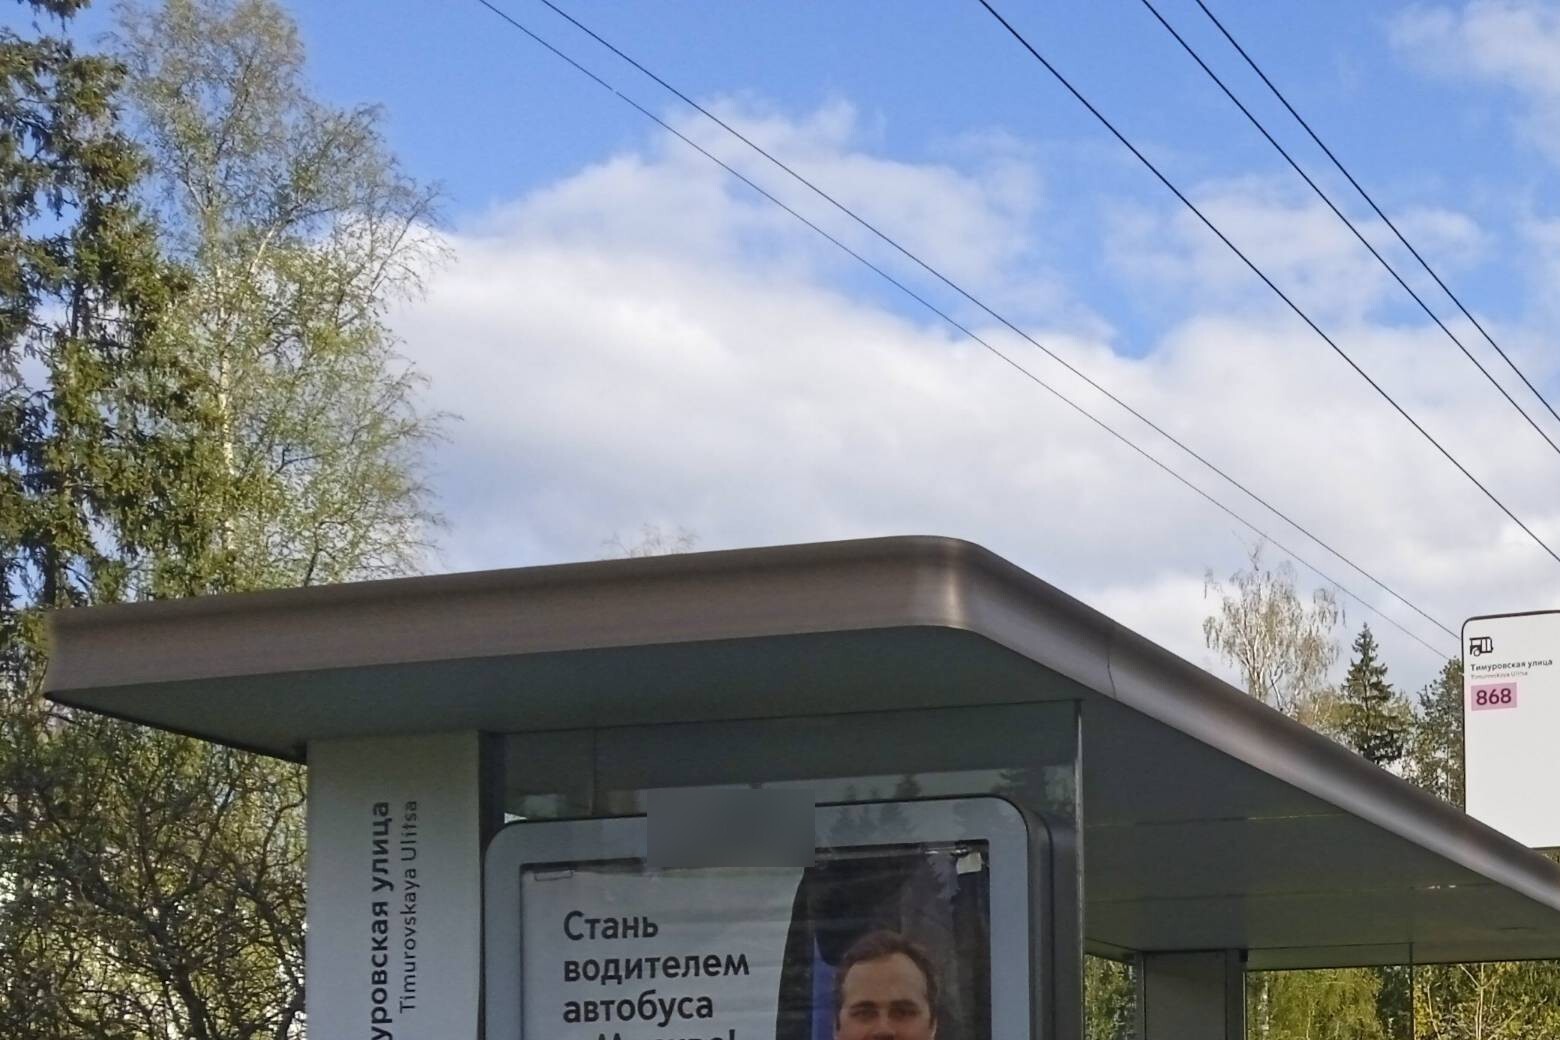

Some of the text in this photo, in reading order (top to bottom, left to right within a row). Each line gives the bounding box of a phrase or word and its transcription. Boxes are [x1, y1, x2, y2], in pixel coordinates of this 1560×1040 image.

[1470, 660, 1553, 672] Тимуровская улица
[1476, 688, 1512, 706] 868
[371, 801, 394, 892] улица
[400, 800, 420, 1014] Timurovskaya Ulitsa
[563, 909, 659, 942] Стань
[563, 954, 751, 986] водителем
[562, 989, 715, 1029] автобуса
